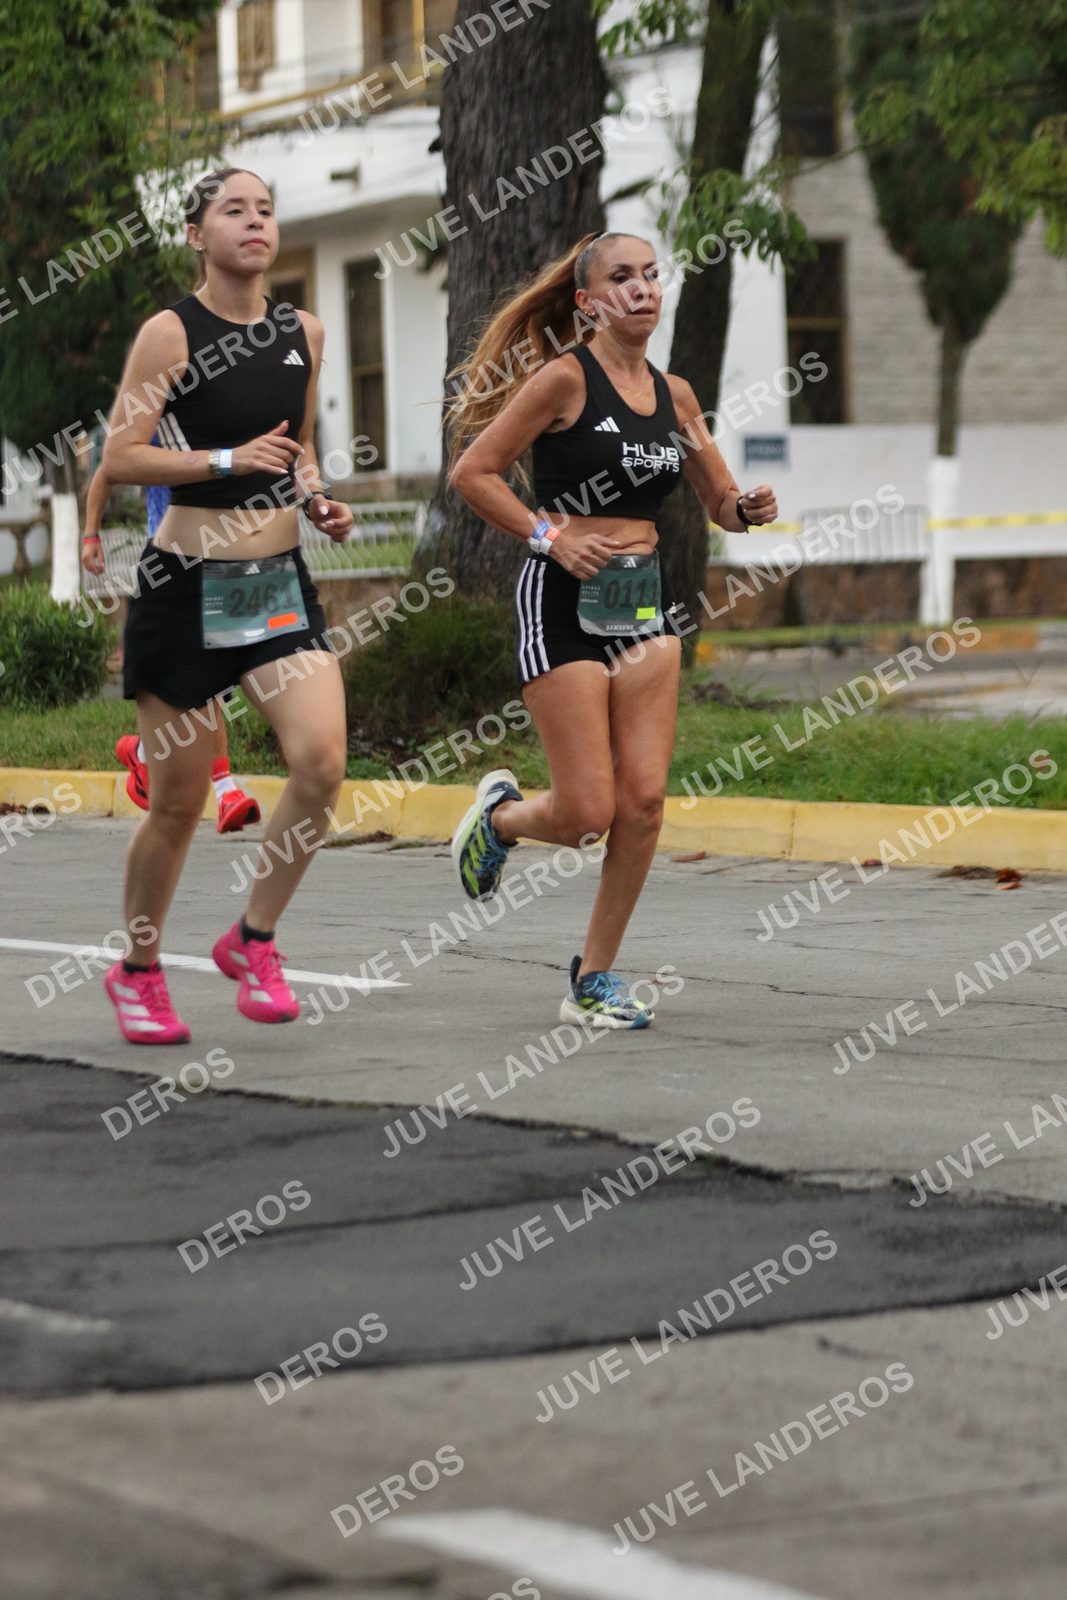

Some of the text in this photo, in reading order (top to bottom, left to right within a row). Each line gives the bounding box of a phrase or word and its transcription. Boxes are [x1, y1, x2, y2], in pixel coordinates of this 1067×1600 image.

[622, 442, 680, 462] HUB
[621, 457, 680, 473] SPORTS
[229, 583, 298, 618] 2461
